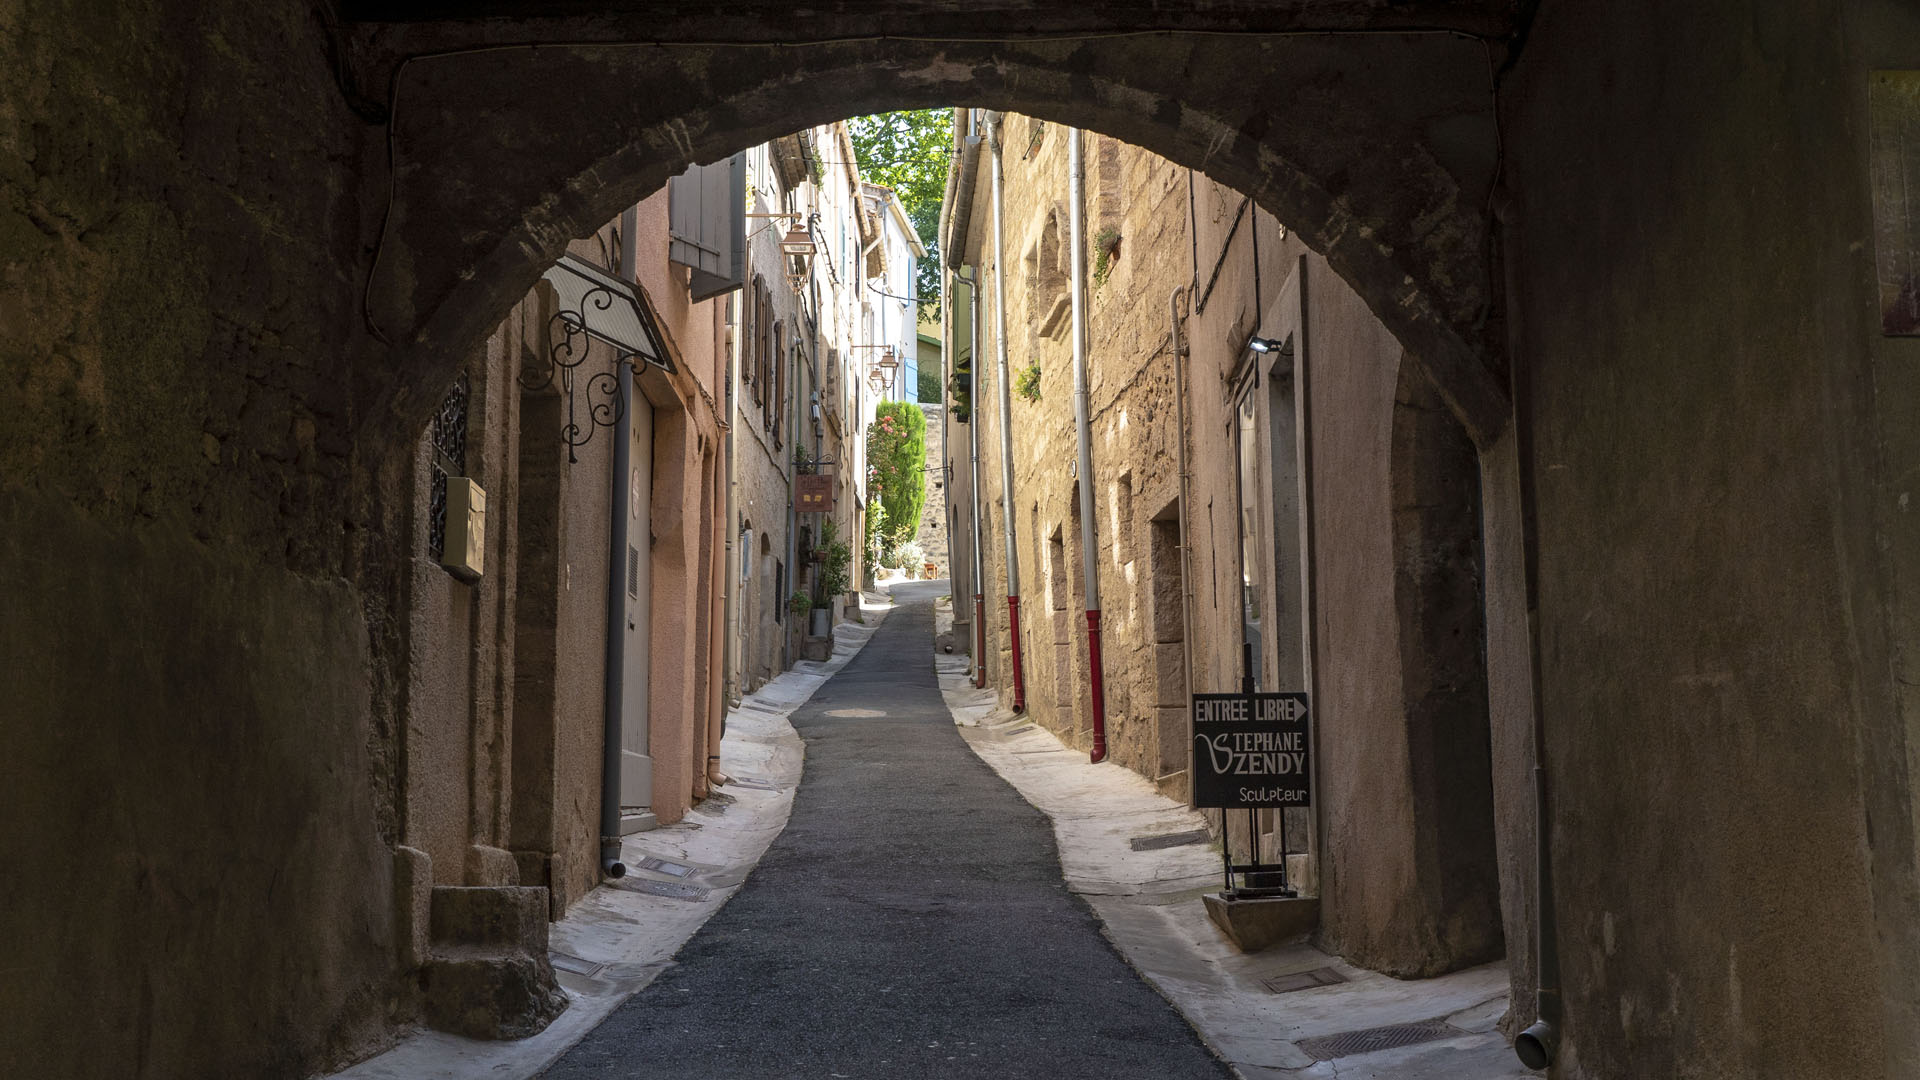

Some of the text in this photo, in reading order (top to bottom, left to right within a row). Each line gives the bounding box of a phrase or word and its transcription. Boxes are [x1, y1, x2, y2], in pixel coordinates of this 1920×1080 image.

[1195, 699, 1294, 721] ENTREE LIBRE
[1233, 752, 1305, 774] ZENDY
[1239, 787, 1307, 802] Sculpteur
